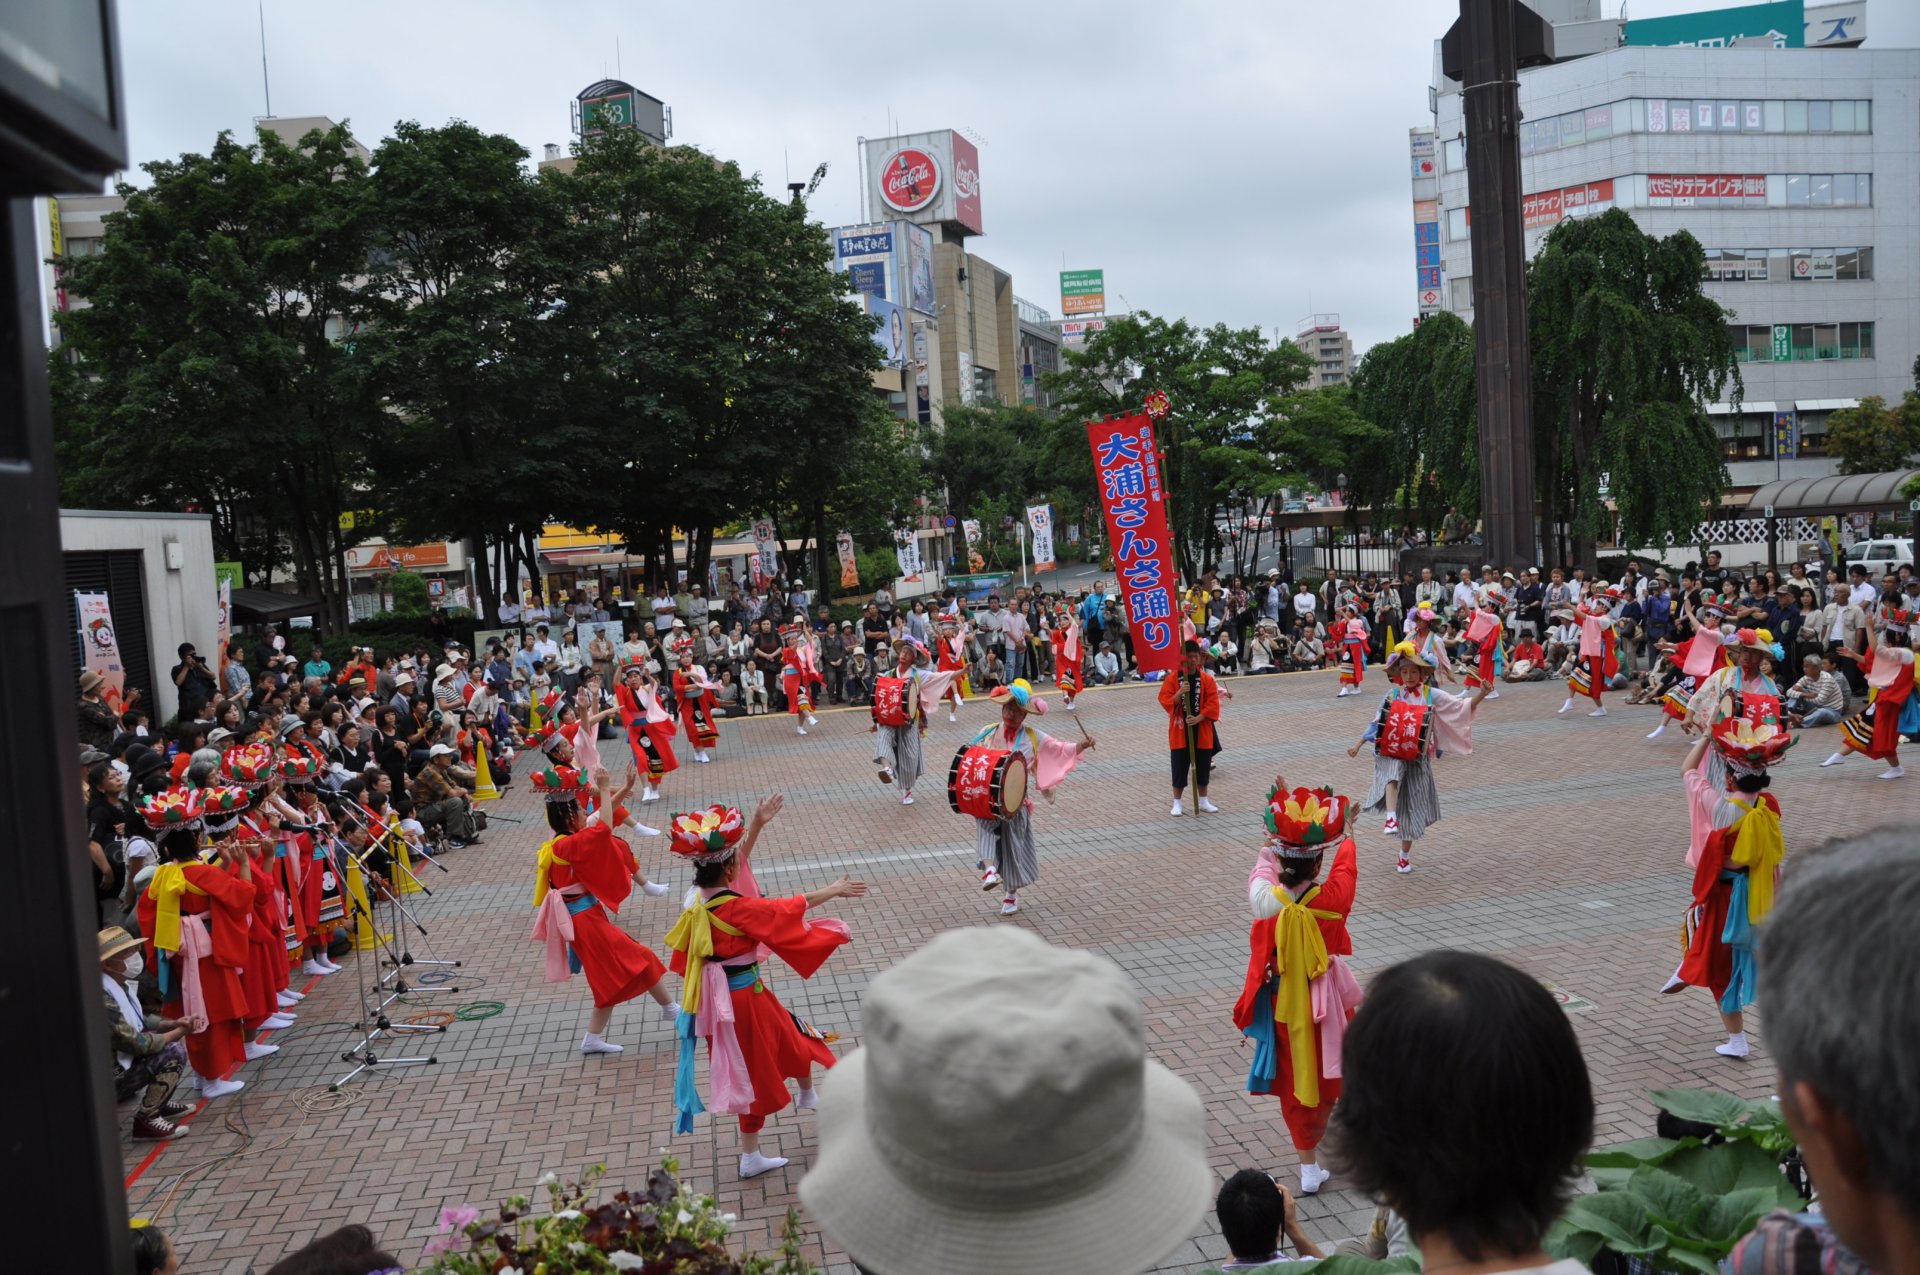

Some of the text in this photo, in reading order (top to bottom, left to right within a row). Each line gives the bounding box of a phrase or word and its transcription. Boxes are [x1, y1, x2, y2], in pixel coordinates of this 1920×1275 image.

[1804, 16, 1856, 42] ズ
[1098, 432, 1171, 650] 大浦さんさ踊り
[1387, 713, 1399, 753] さんさ
[1402, 711, 1417, 737] 大浦
[973, 754, 990, 781] 大浦
